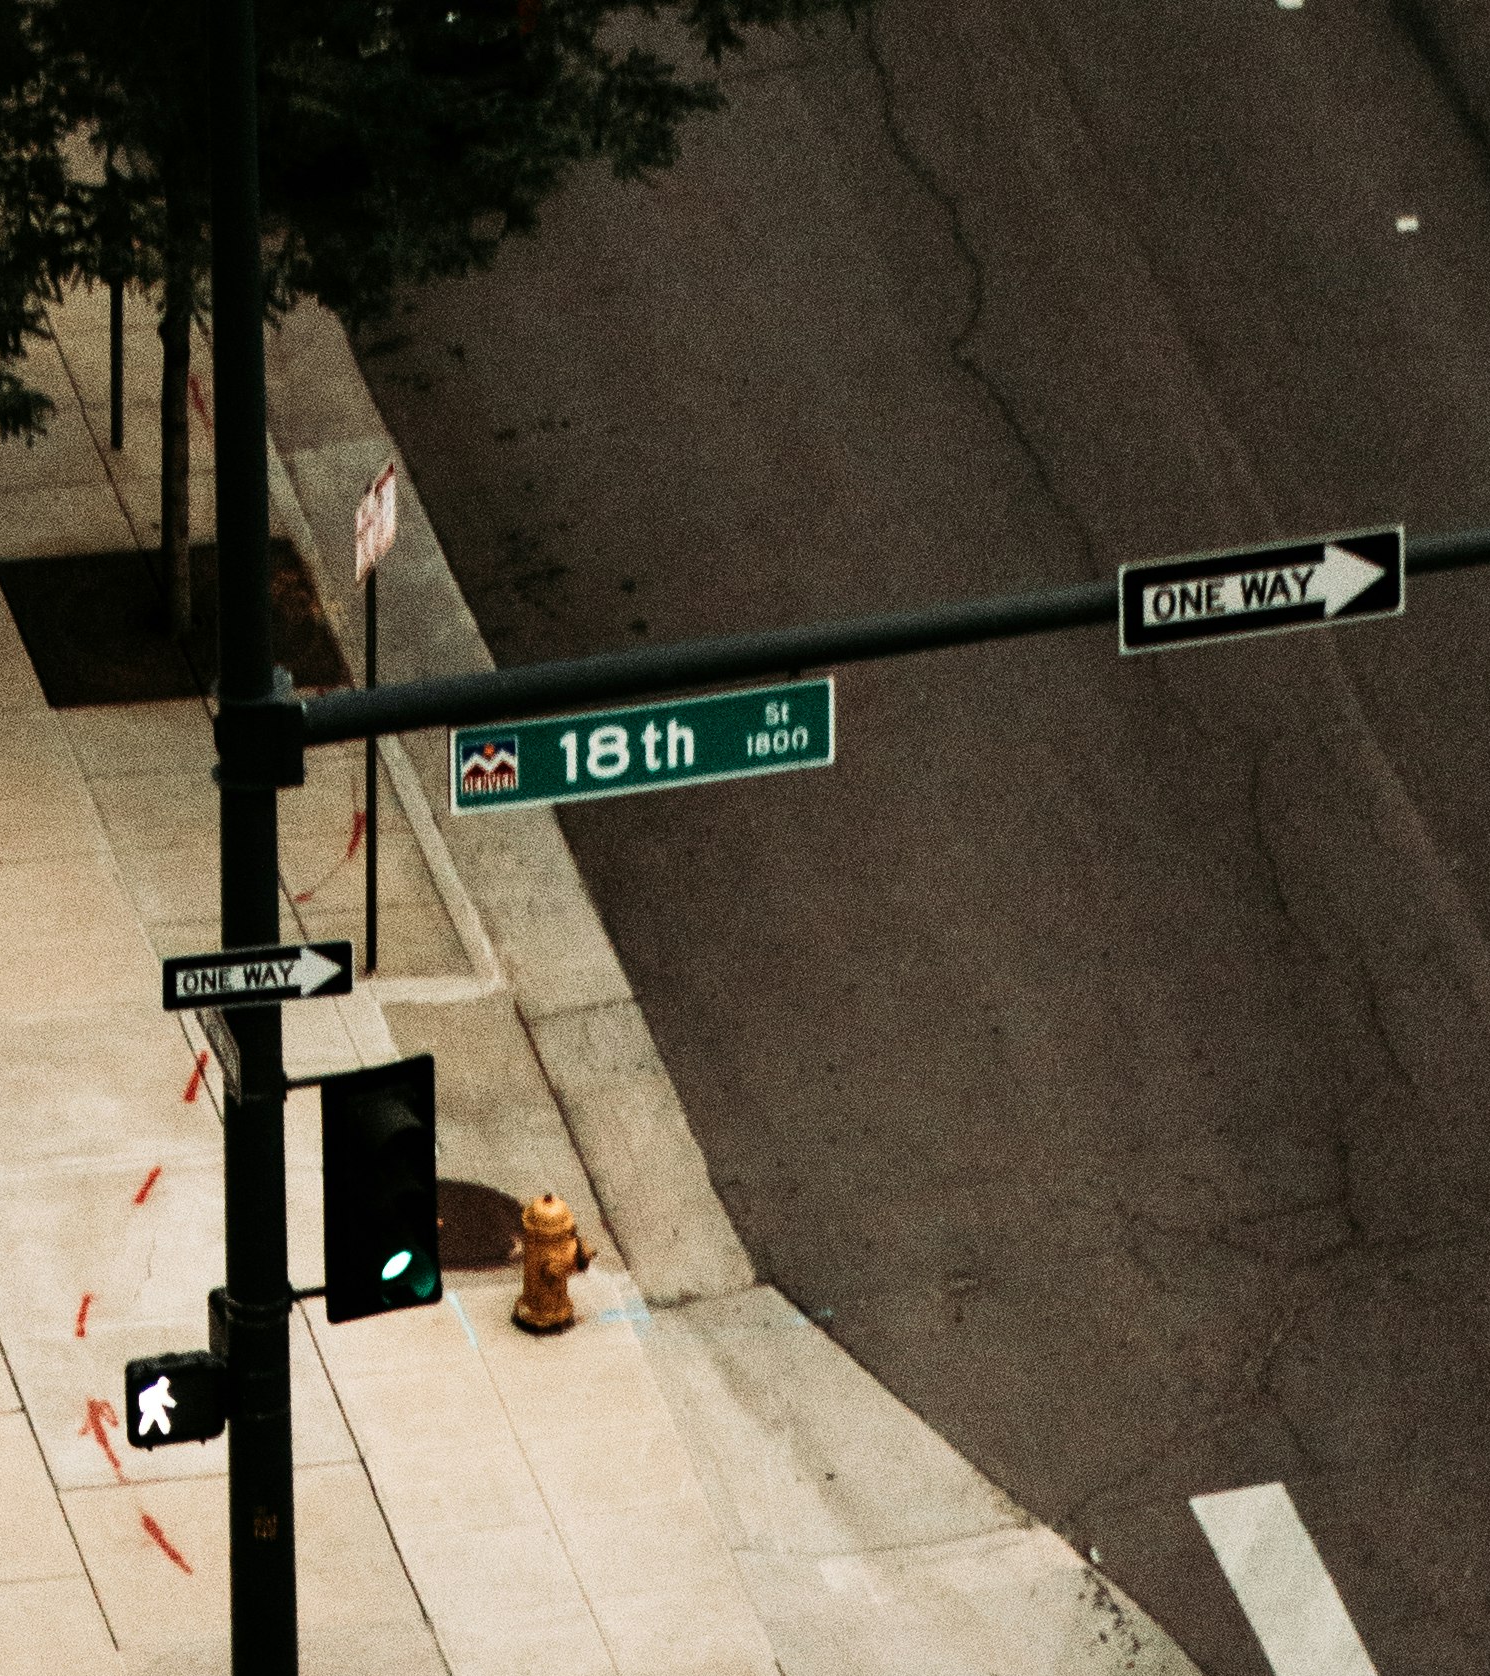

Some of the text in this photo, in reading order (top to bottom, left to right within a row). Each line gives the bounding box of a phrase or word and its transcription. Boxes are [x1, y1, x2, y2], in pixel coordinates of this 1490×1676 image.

[1151, 569, 1313, 622] ONE WAY
[559, 700, 791, 784] 18th St
[745, 725, 809, 758] 1800
[182, 960, 294, 996] ONE WAY
